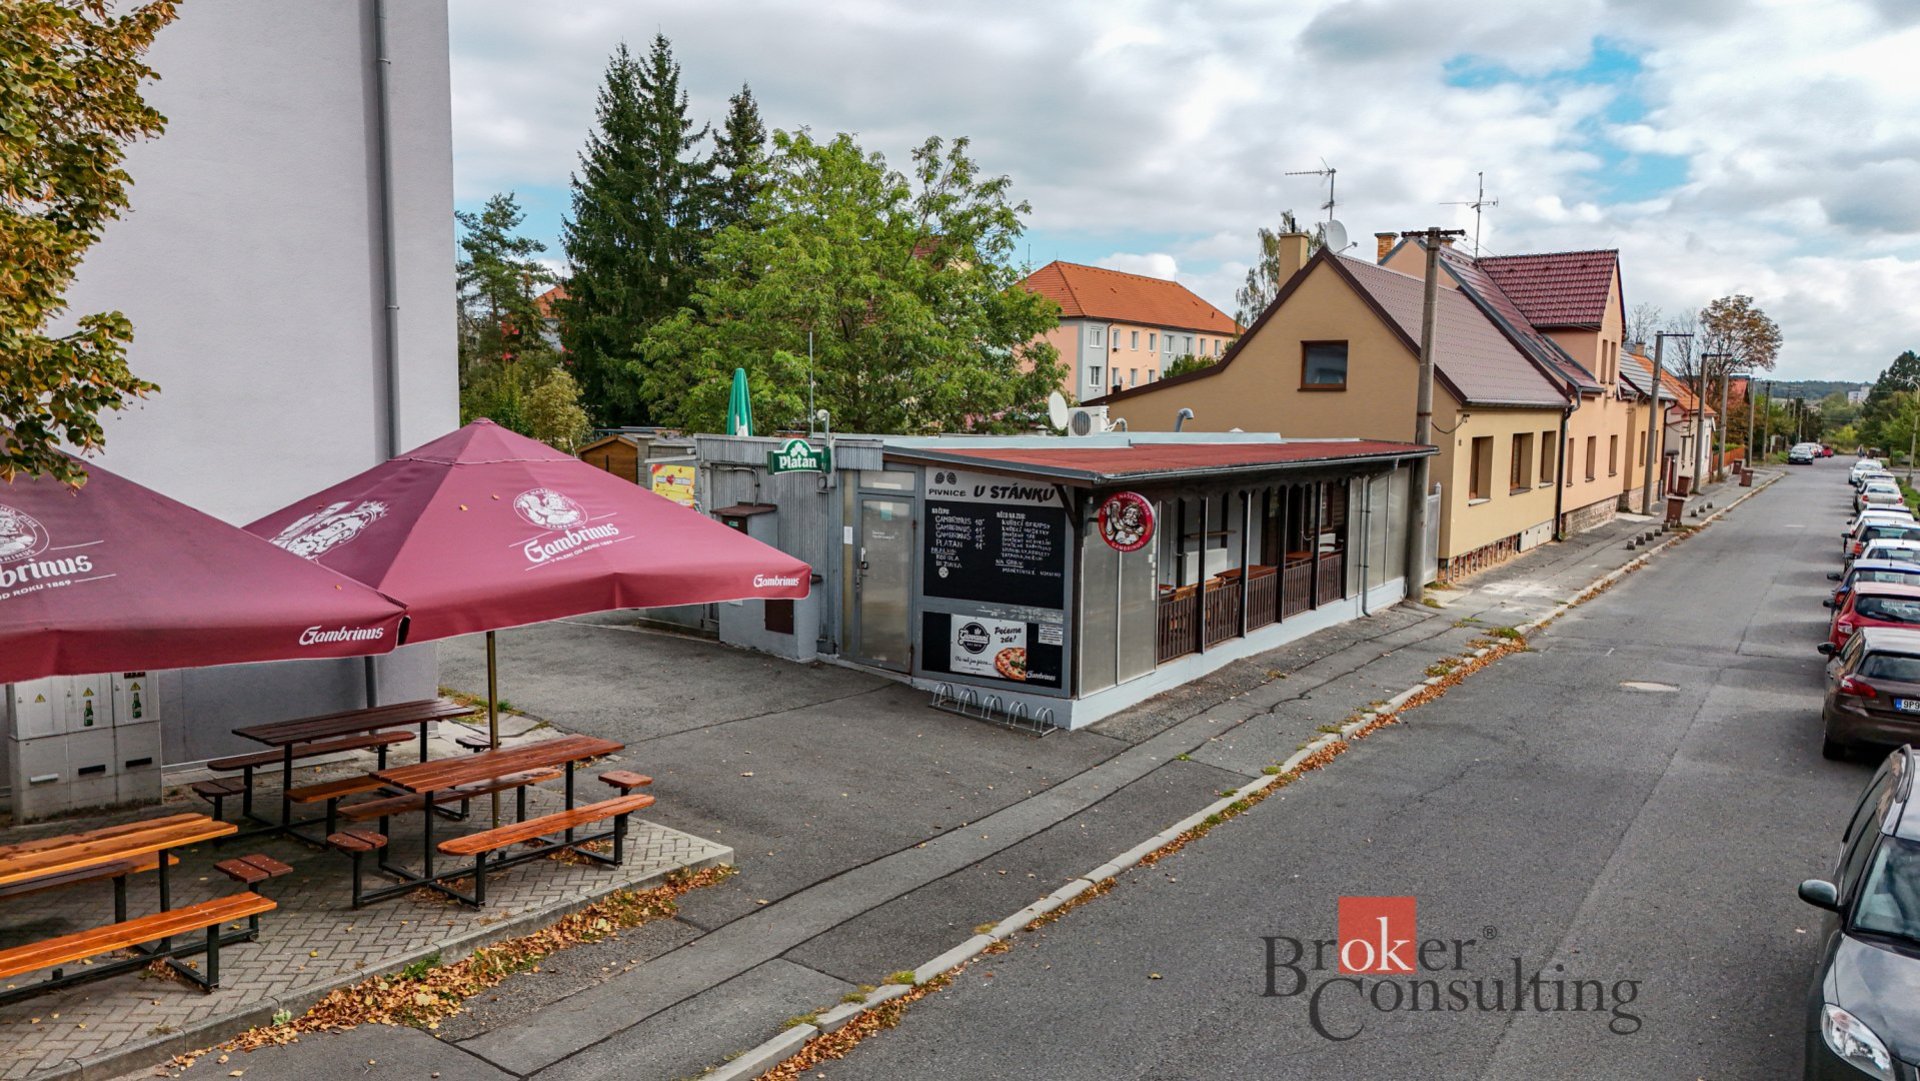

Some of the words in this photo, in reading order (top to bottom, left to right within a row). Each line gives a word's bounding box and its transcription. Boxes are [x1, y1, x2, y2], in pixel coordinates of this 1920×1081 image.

[779, 455, 817, 469] Platan
[929, 488, 966, 497] PIVNICE
[973, 485, 985, 497] U
[990, 482, 1055, 503] STÁNKU
[524, 523, 619, 563] Gambrinus
[13, 584, 43, 596] ROKU
[46, 579, 71, 588] 1869
[753, 574, 800, 588] Gambrinus
[299, 625, 384, 646] Gambrinus
